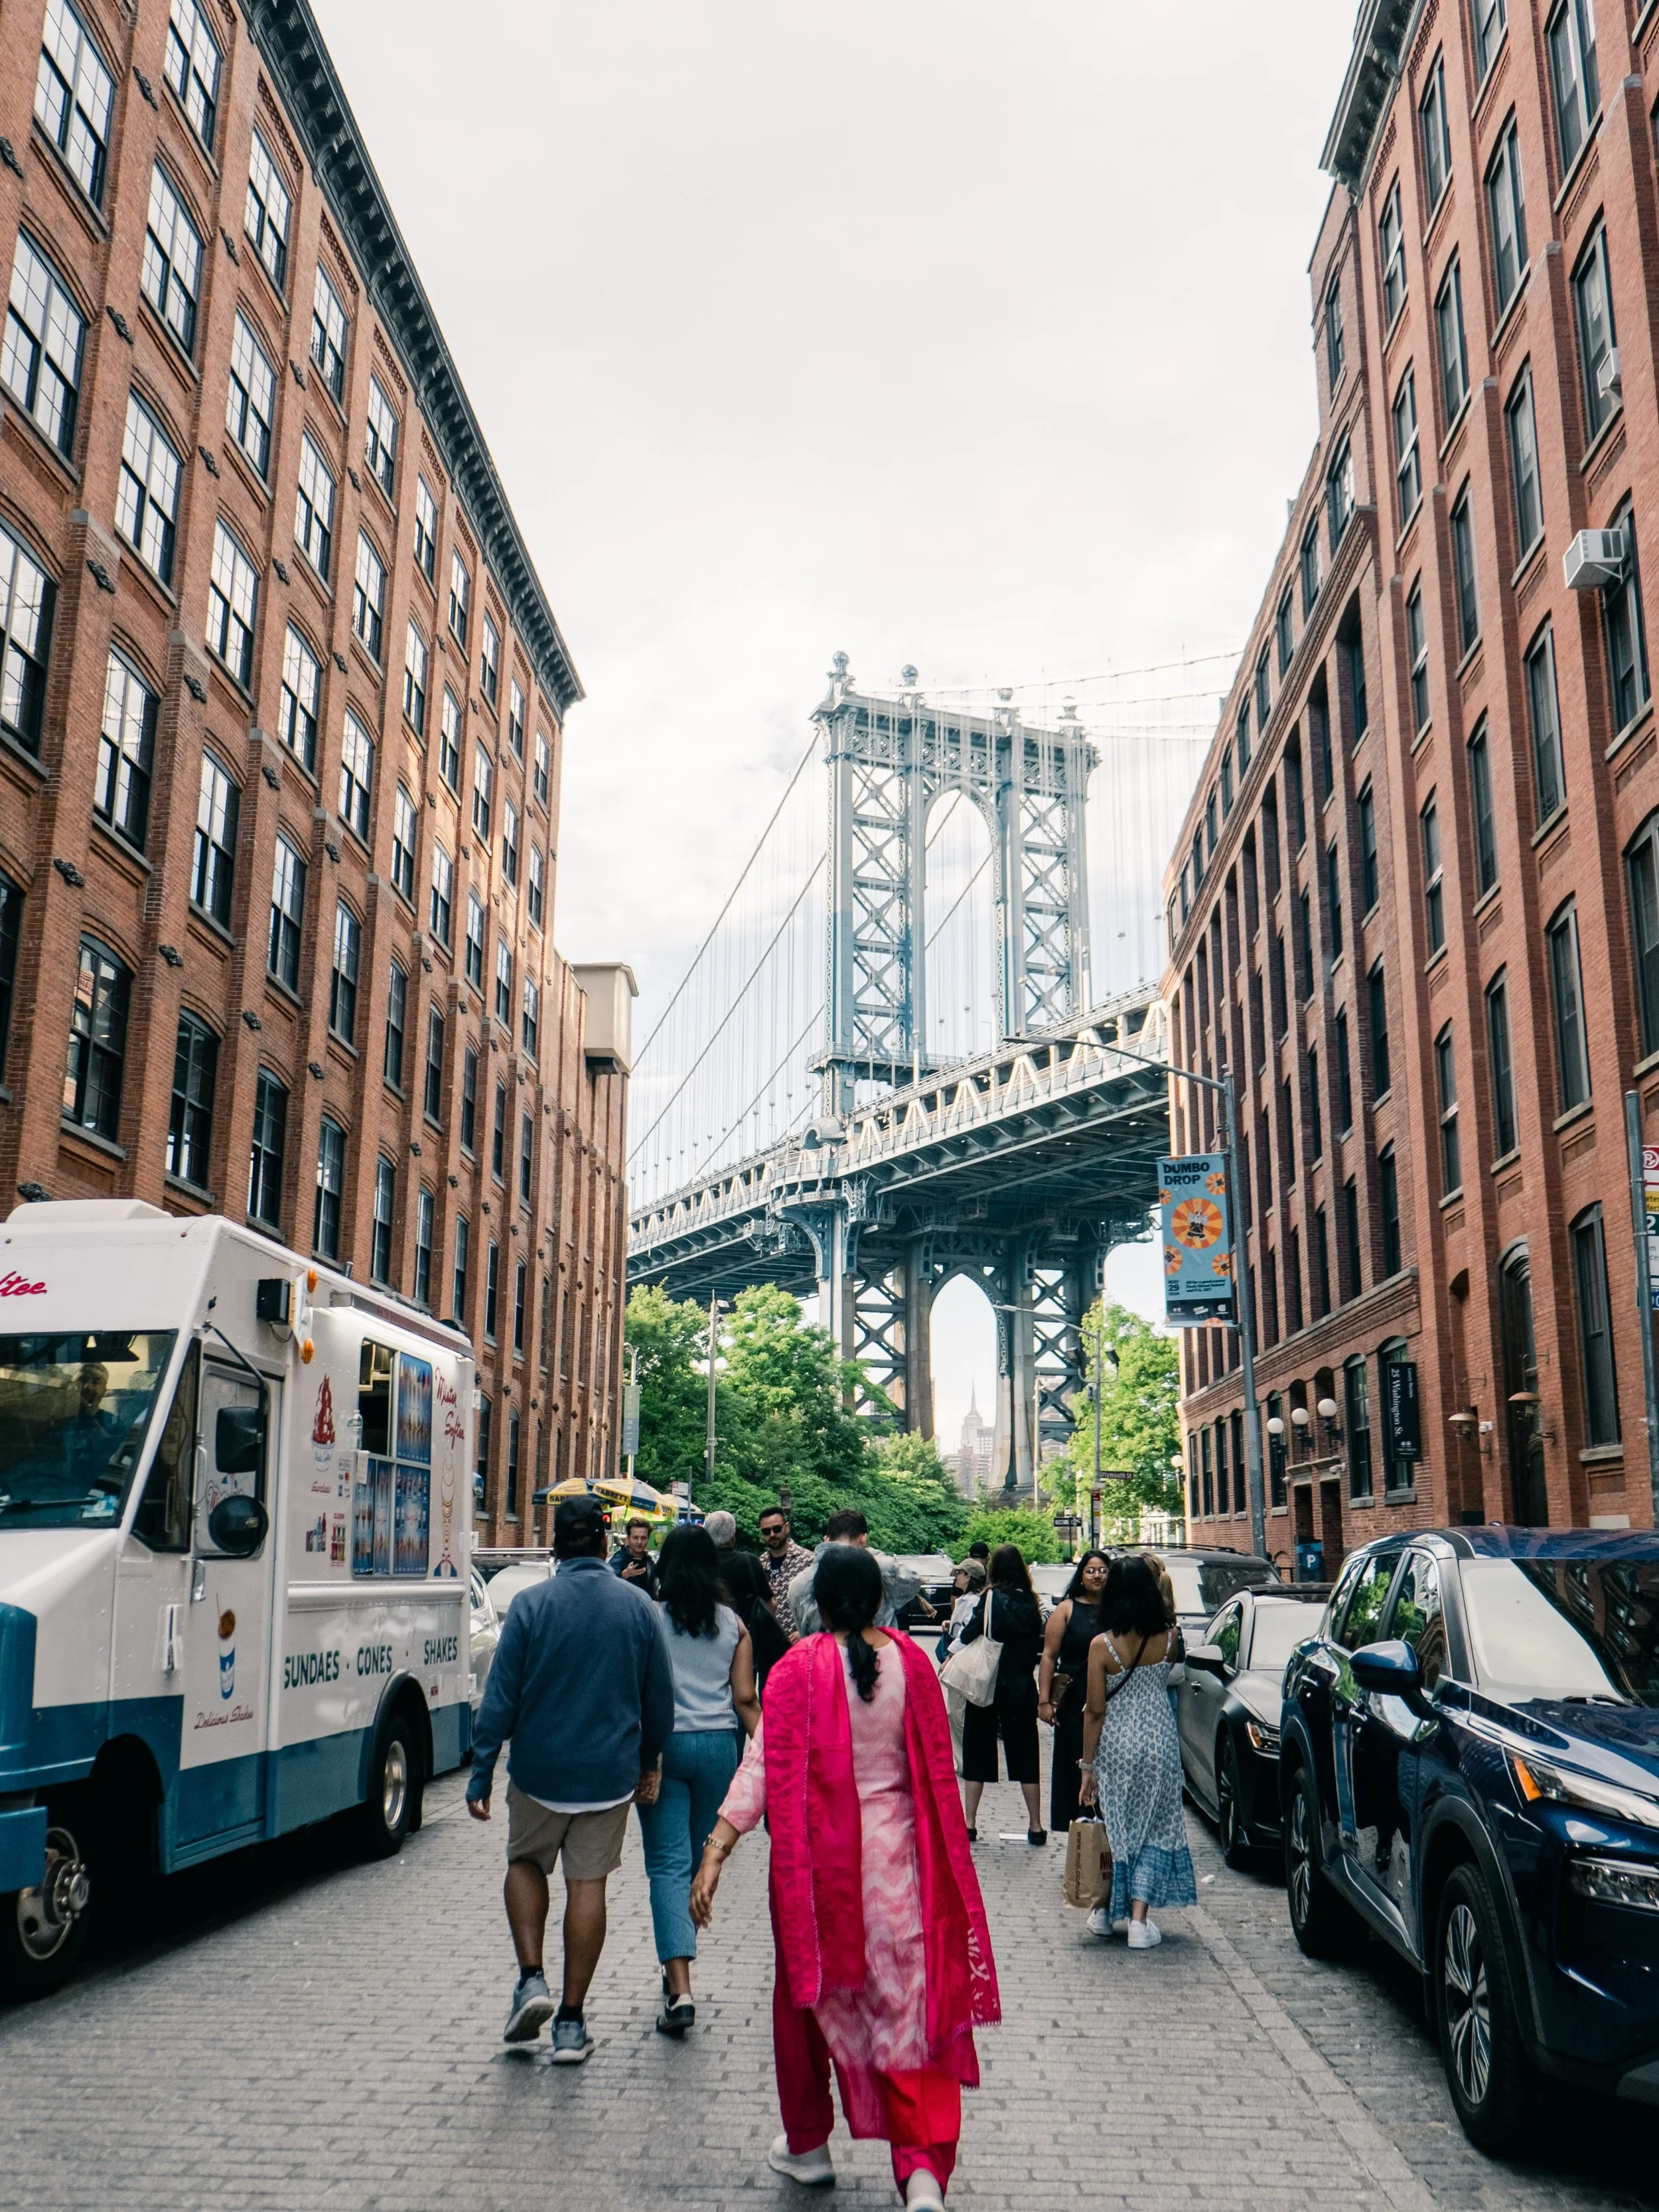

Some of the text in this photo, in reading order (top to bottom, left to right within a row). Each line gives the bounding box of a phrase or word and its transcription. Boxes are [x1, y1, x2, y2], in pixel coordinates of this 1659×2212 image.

[1163, 1162, 1210, 1173] DUMBO
[1164, 1175, 1200, 1185] DROP
[1391, 1368, 1403, 1437] 25 Washington St.
[595, 1487, 628, 1502] SABRETT
[1307, 1554, 1316, 1568] P
[284, 1636, 458, 1690] SUNDAES CONES SHAKES
[194, 1705, 253, 1730] Delicious Shakes
